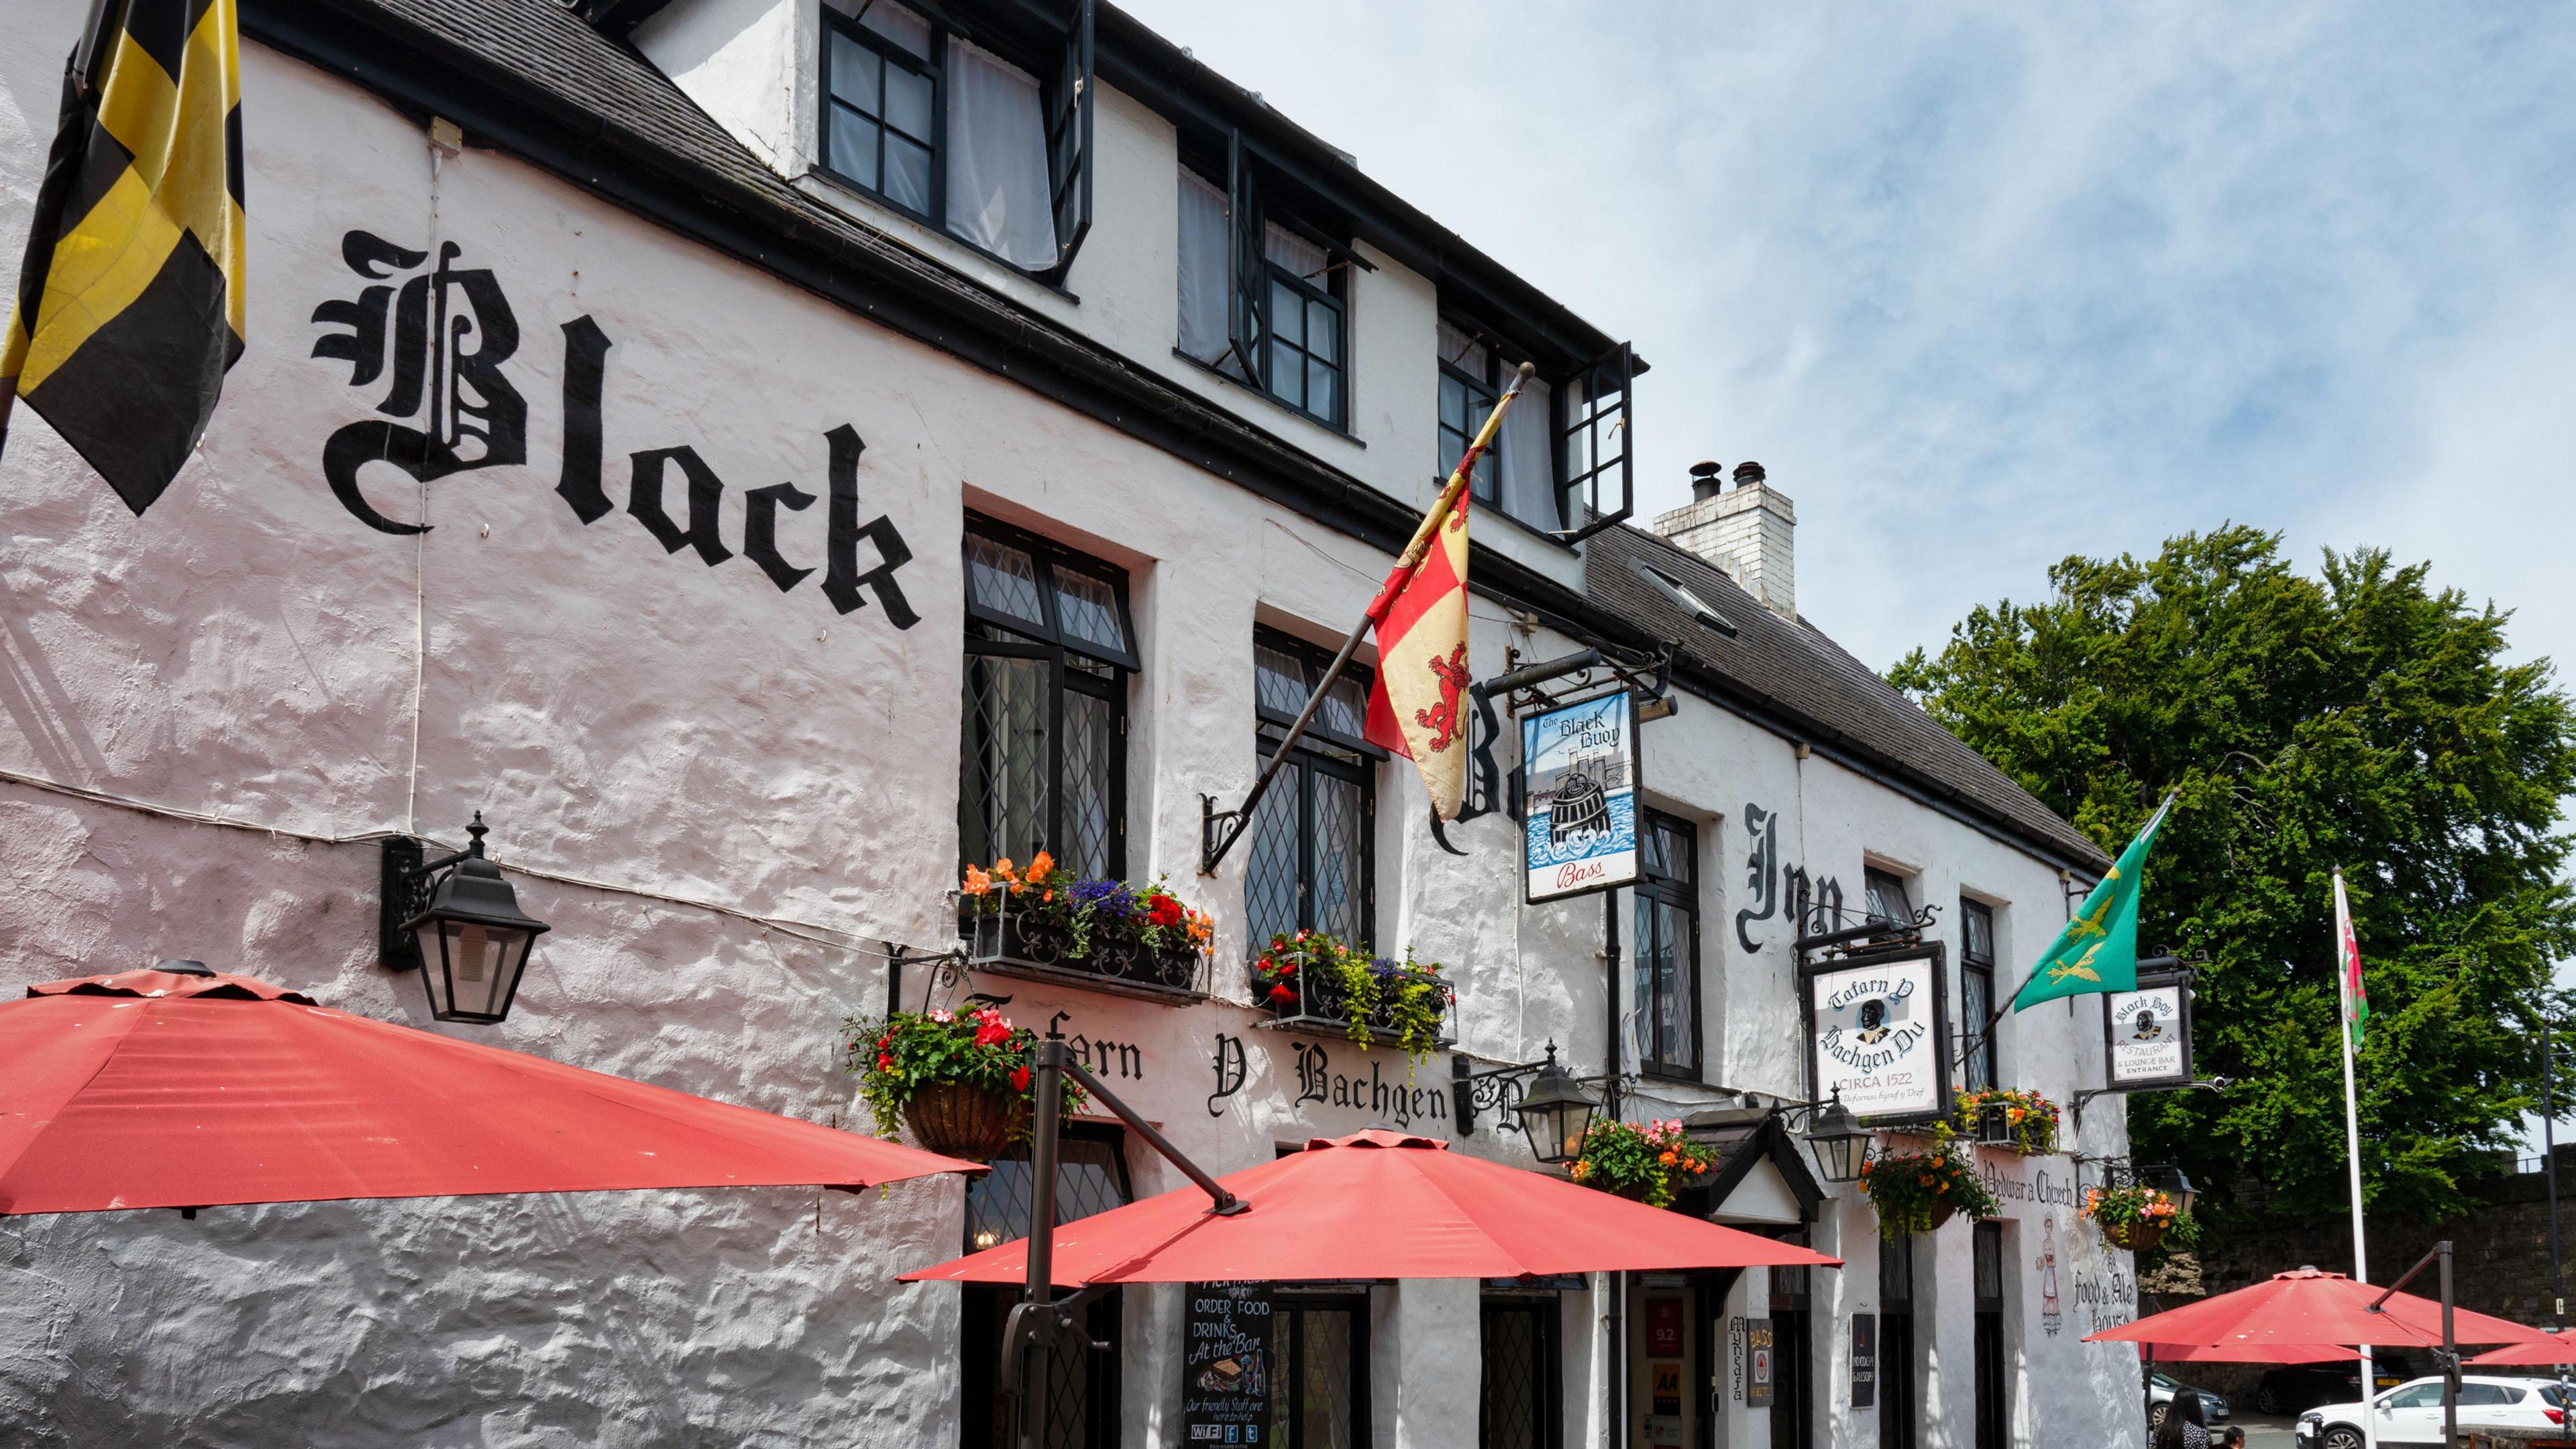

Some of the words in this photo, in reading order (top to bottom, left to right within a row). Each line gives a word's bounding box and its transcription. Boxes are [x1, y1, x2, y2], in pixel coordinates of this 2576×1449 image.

[311, 229, 922, 631] Black
[1542, 716, 1558, 729] The
[1558, 711, 1605, 739] Black
[1579, 725, 1621, 751] Buoy
[1556, 861, 1605, 889] Bass
[1735, 802, 1843, 954] Inn
[1828, 978, 1889, 1012] Tafarn
[2114, 996, 2148, 1024] Black
[2149, 996, 2174, 1017] Boy
[1819, 1024, 1895, 1074] Bachgen
[1889, 1020, 1926, 1059] Du
[2116, 1032, 2176, 1057] RESTAURANT
[2117, 1060, 2123, 1068] &
[2124, 1057, 2157, 1067] LOUNGE
[2158, 1056, 2176, 1064] BAR
[2127, 1065, 2168, 1074] ENTRANCE
[1291, 1042, 1447, 1130] Bachgen
[1839, 1076, 1881, 1091] CIRCA
[1886, 1072, 1913, 1087] 1522
[1906, 1086, 1926, 1097] Dref
[1983, 1159, 2027, 1200] Pedwar
[2027, 1182, 2035, 1201] a
[2036, 1169, 2074, 1208] Chwech
[2102, 1286, 2109, 1305] &
[2112, 1273, 2133, 1305] Ale
[1195, 1299, 1232, 1314] ORDER
[1238, 1300, 1270, 1315] FOOD
[1224, 1313, 1232, 1324] &
[1193, 1322, 1237, 1340] DRINKS
[1656, 1328, 1675, 1341] 9.2
[1749, 1329, 1773, 1349] BASS
[1189, 1341, 1210, 1365] At
[1212, 1339, 1233, 1358] the
[1232, 1332, 1260, 1354] Bar
[1728, 1316, 1746, 1401] Mynedfa
[1657, 1373, 1678, 1391] AA
[1186, 1399, 1201, 1412] Our
[1201, 1397, 1230, 1413] friendly
[1231, 1397, 1250, 1411] Staff
[1249, 1401, 1263, 1411] are
[1213, 1411, 1230, 1421] here
[1229, 1411, 1238, 1421] to
[1237, 1411, 1253, 1424] help
